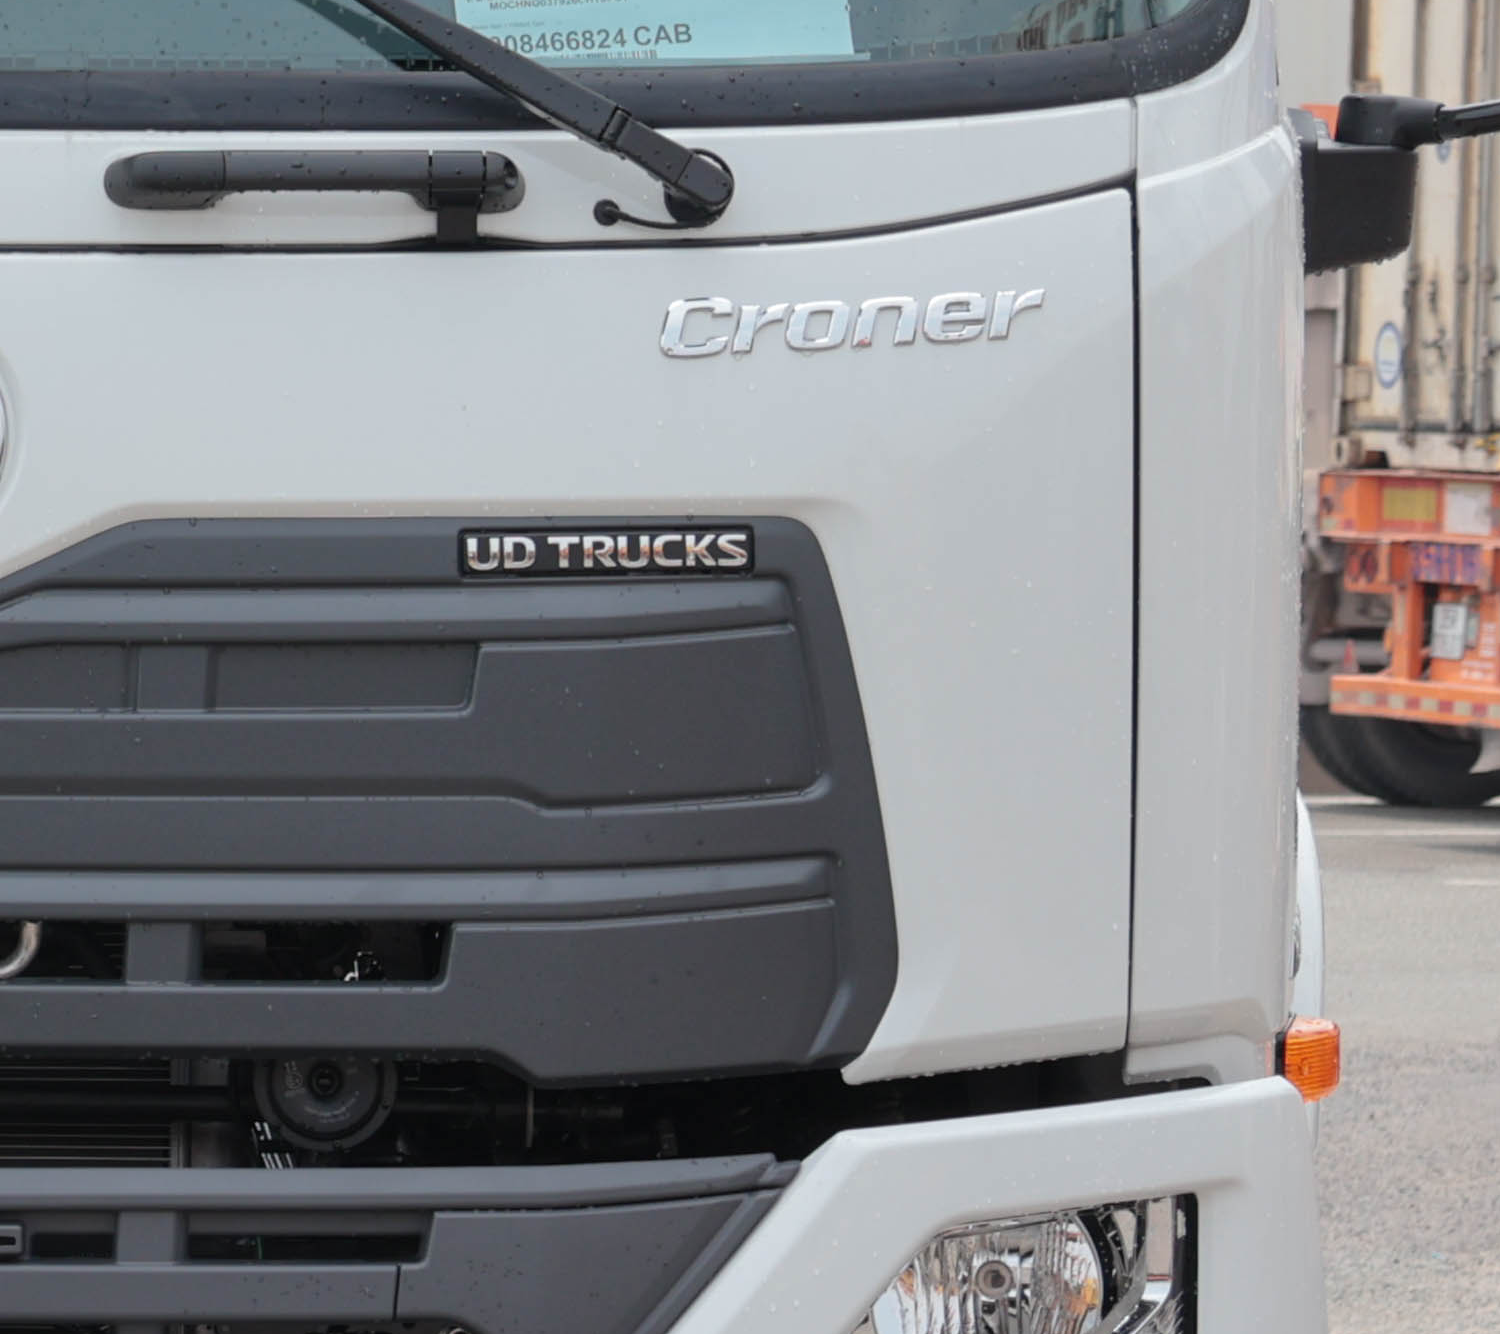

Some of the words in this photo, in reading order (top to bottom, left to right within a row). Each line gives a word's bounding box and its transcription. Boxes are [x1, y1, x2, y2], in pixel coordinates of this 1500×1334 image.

[634, 23, 693, 46] CAB
[658, 288, 1046, 359] Croner
[464, 534, 536, 571] UD
[547, 531, 748, 570] TRUCKS
